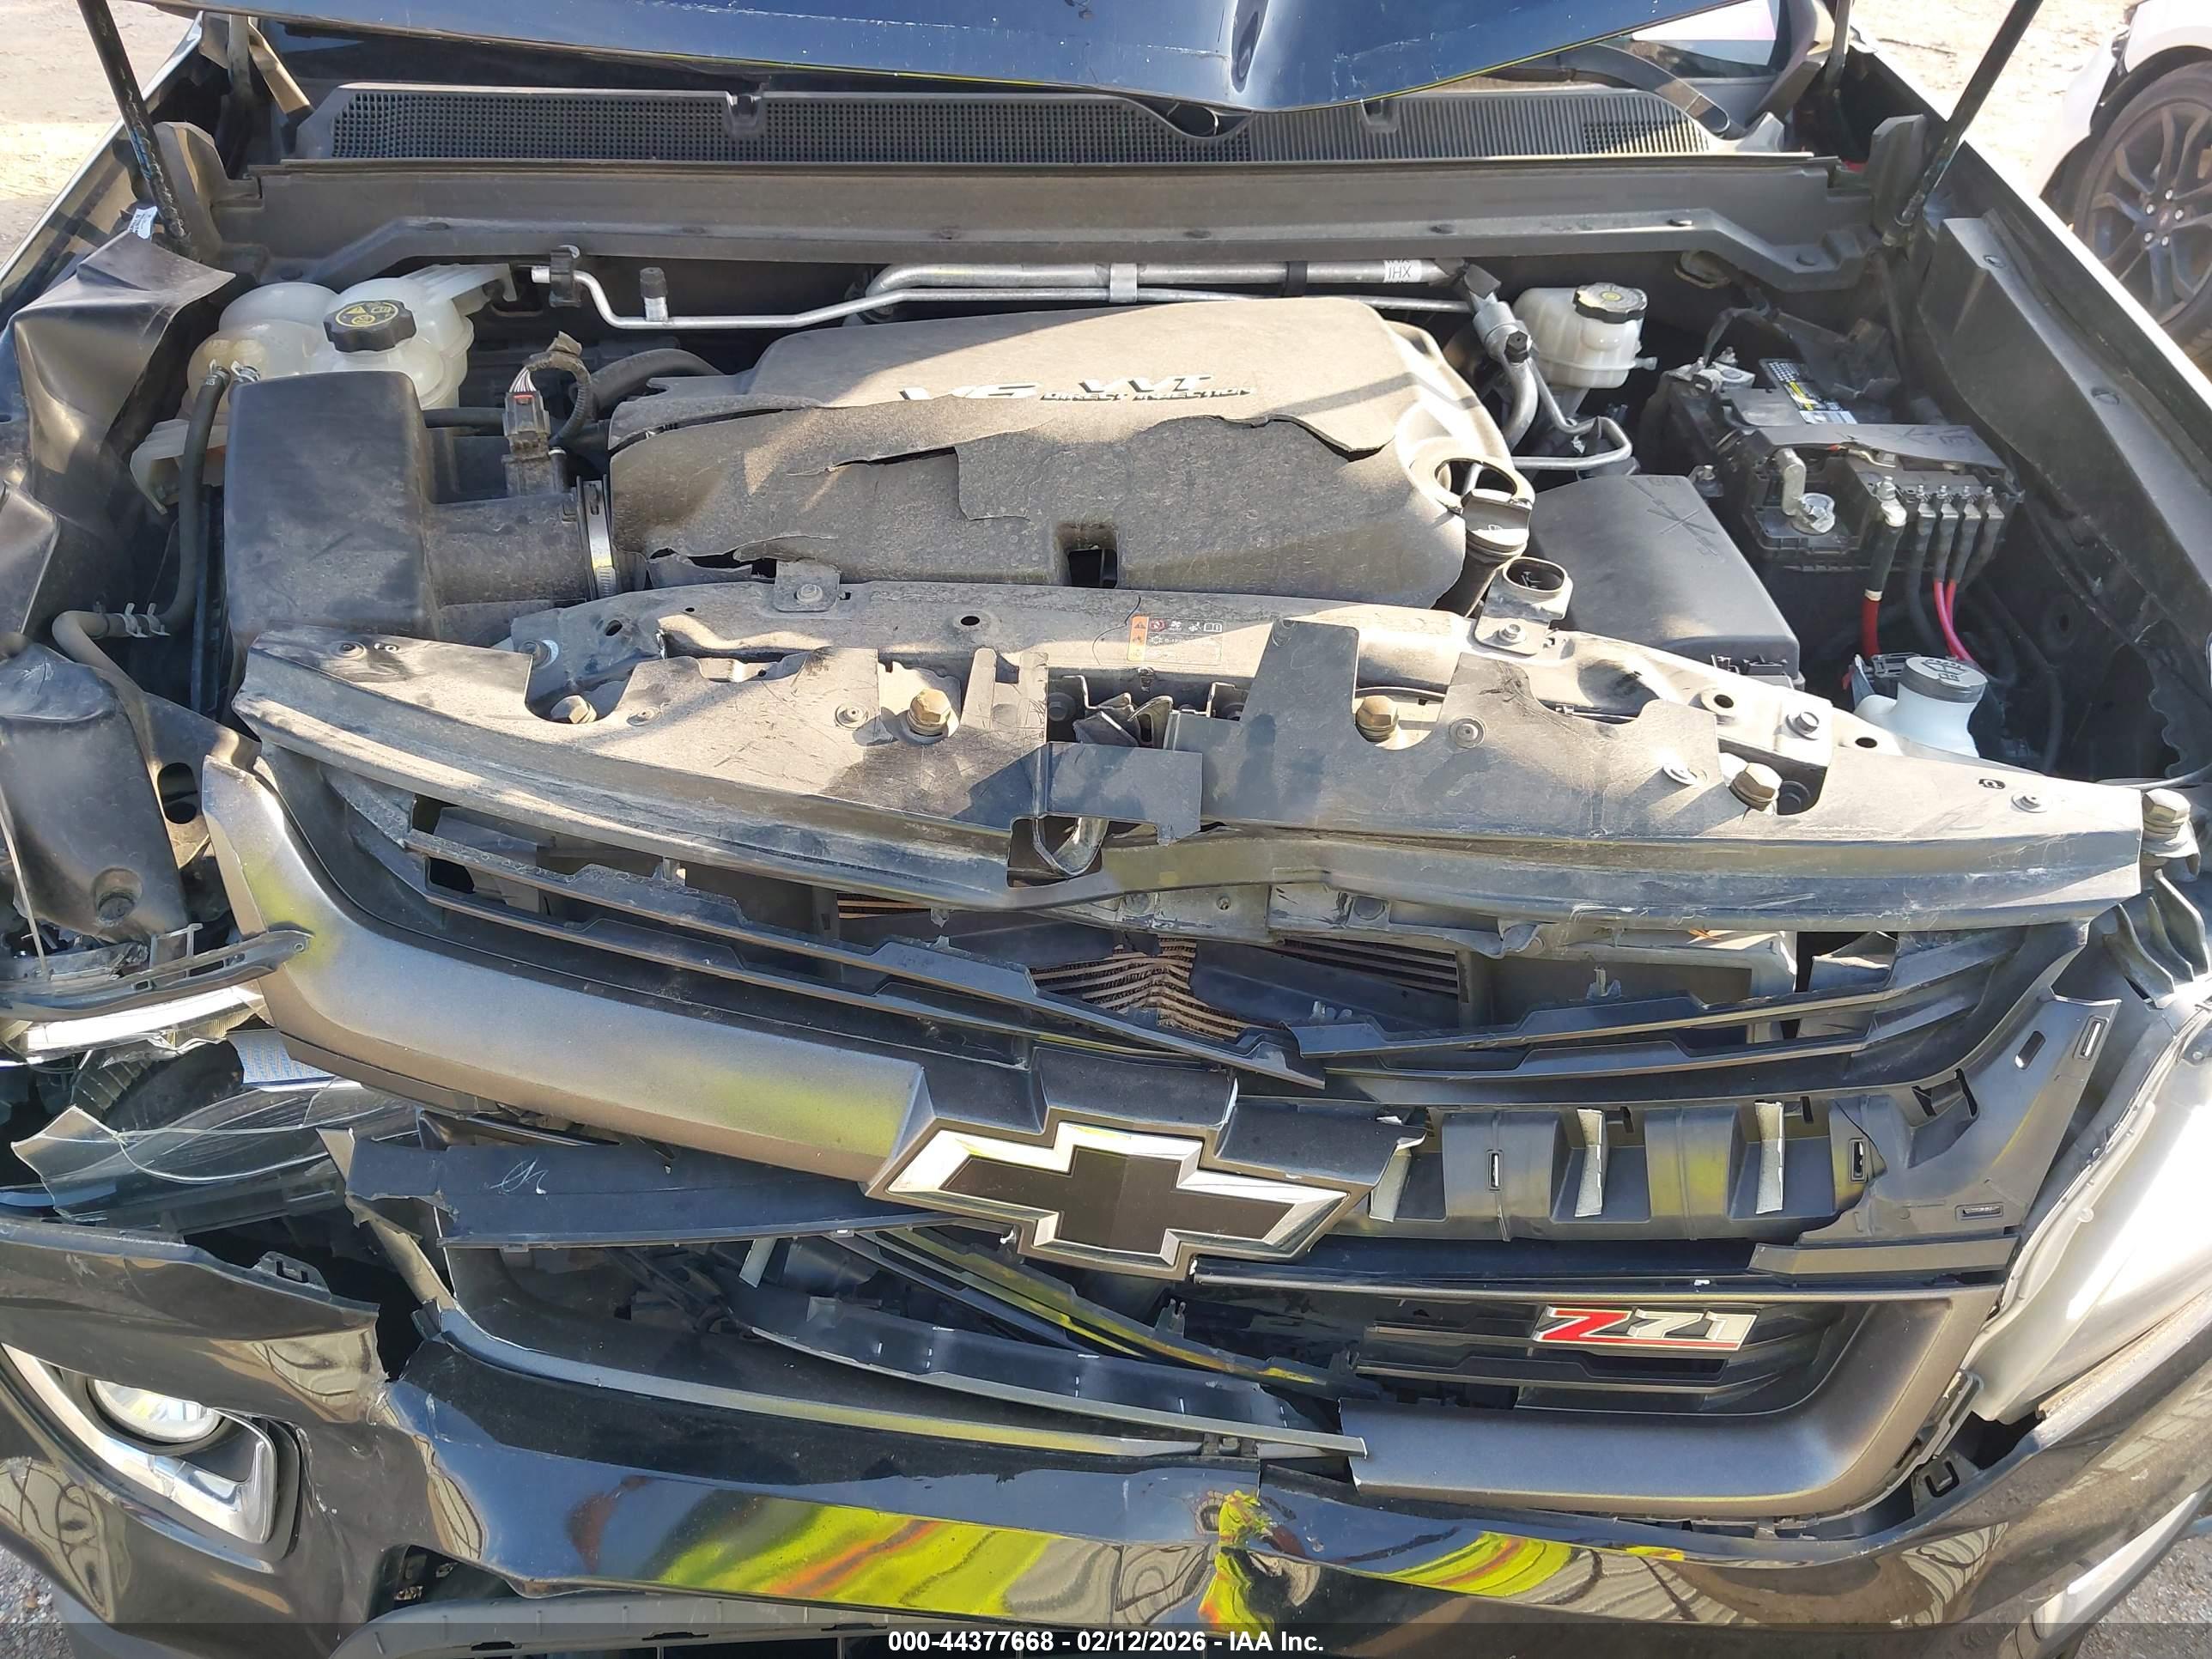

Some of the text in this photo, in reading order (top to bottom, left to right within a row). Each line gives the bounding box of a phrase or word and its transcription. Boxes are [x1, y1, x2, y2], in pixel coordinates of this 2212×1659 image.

[1079, 374, 1212, 393] VVT
[1040, 387, 1255, 402] DIRECT INJECTION
[1531, 1304, 1759, 1351] Z71
